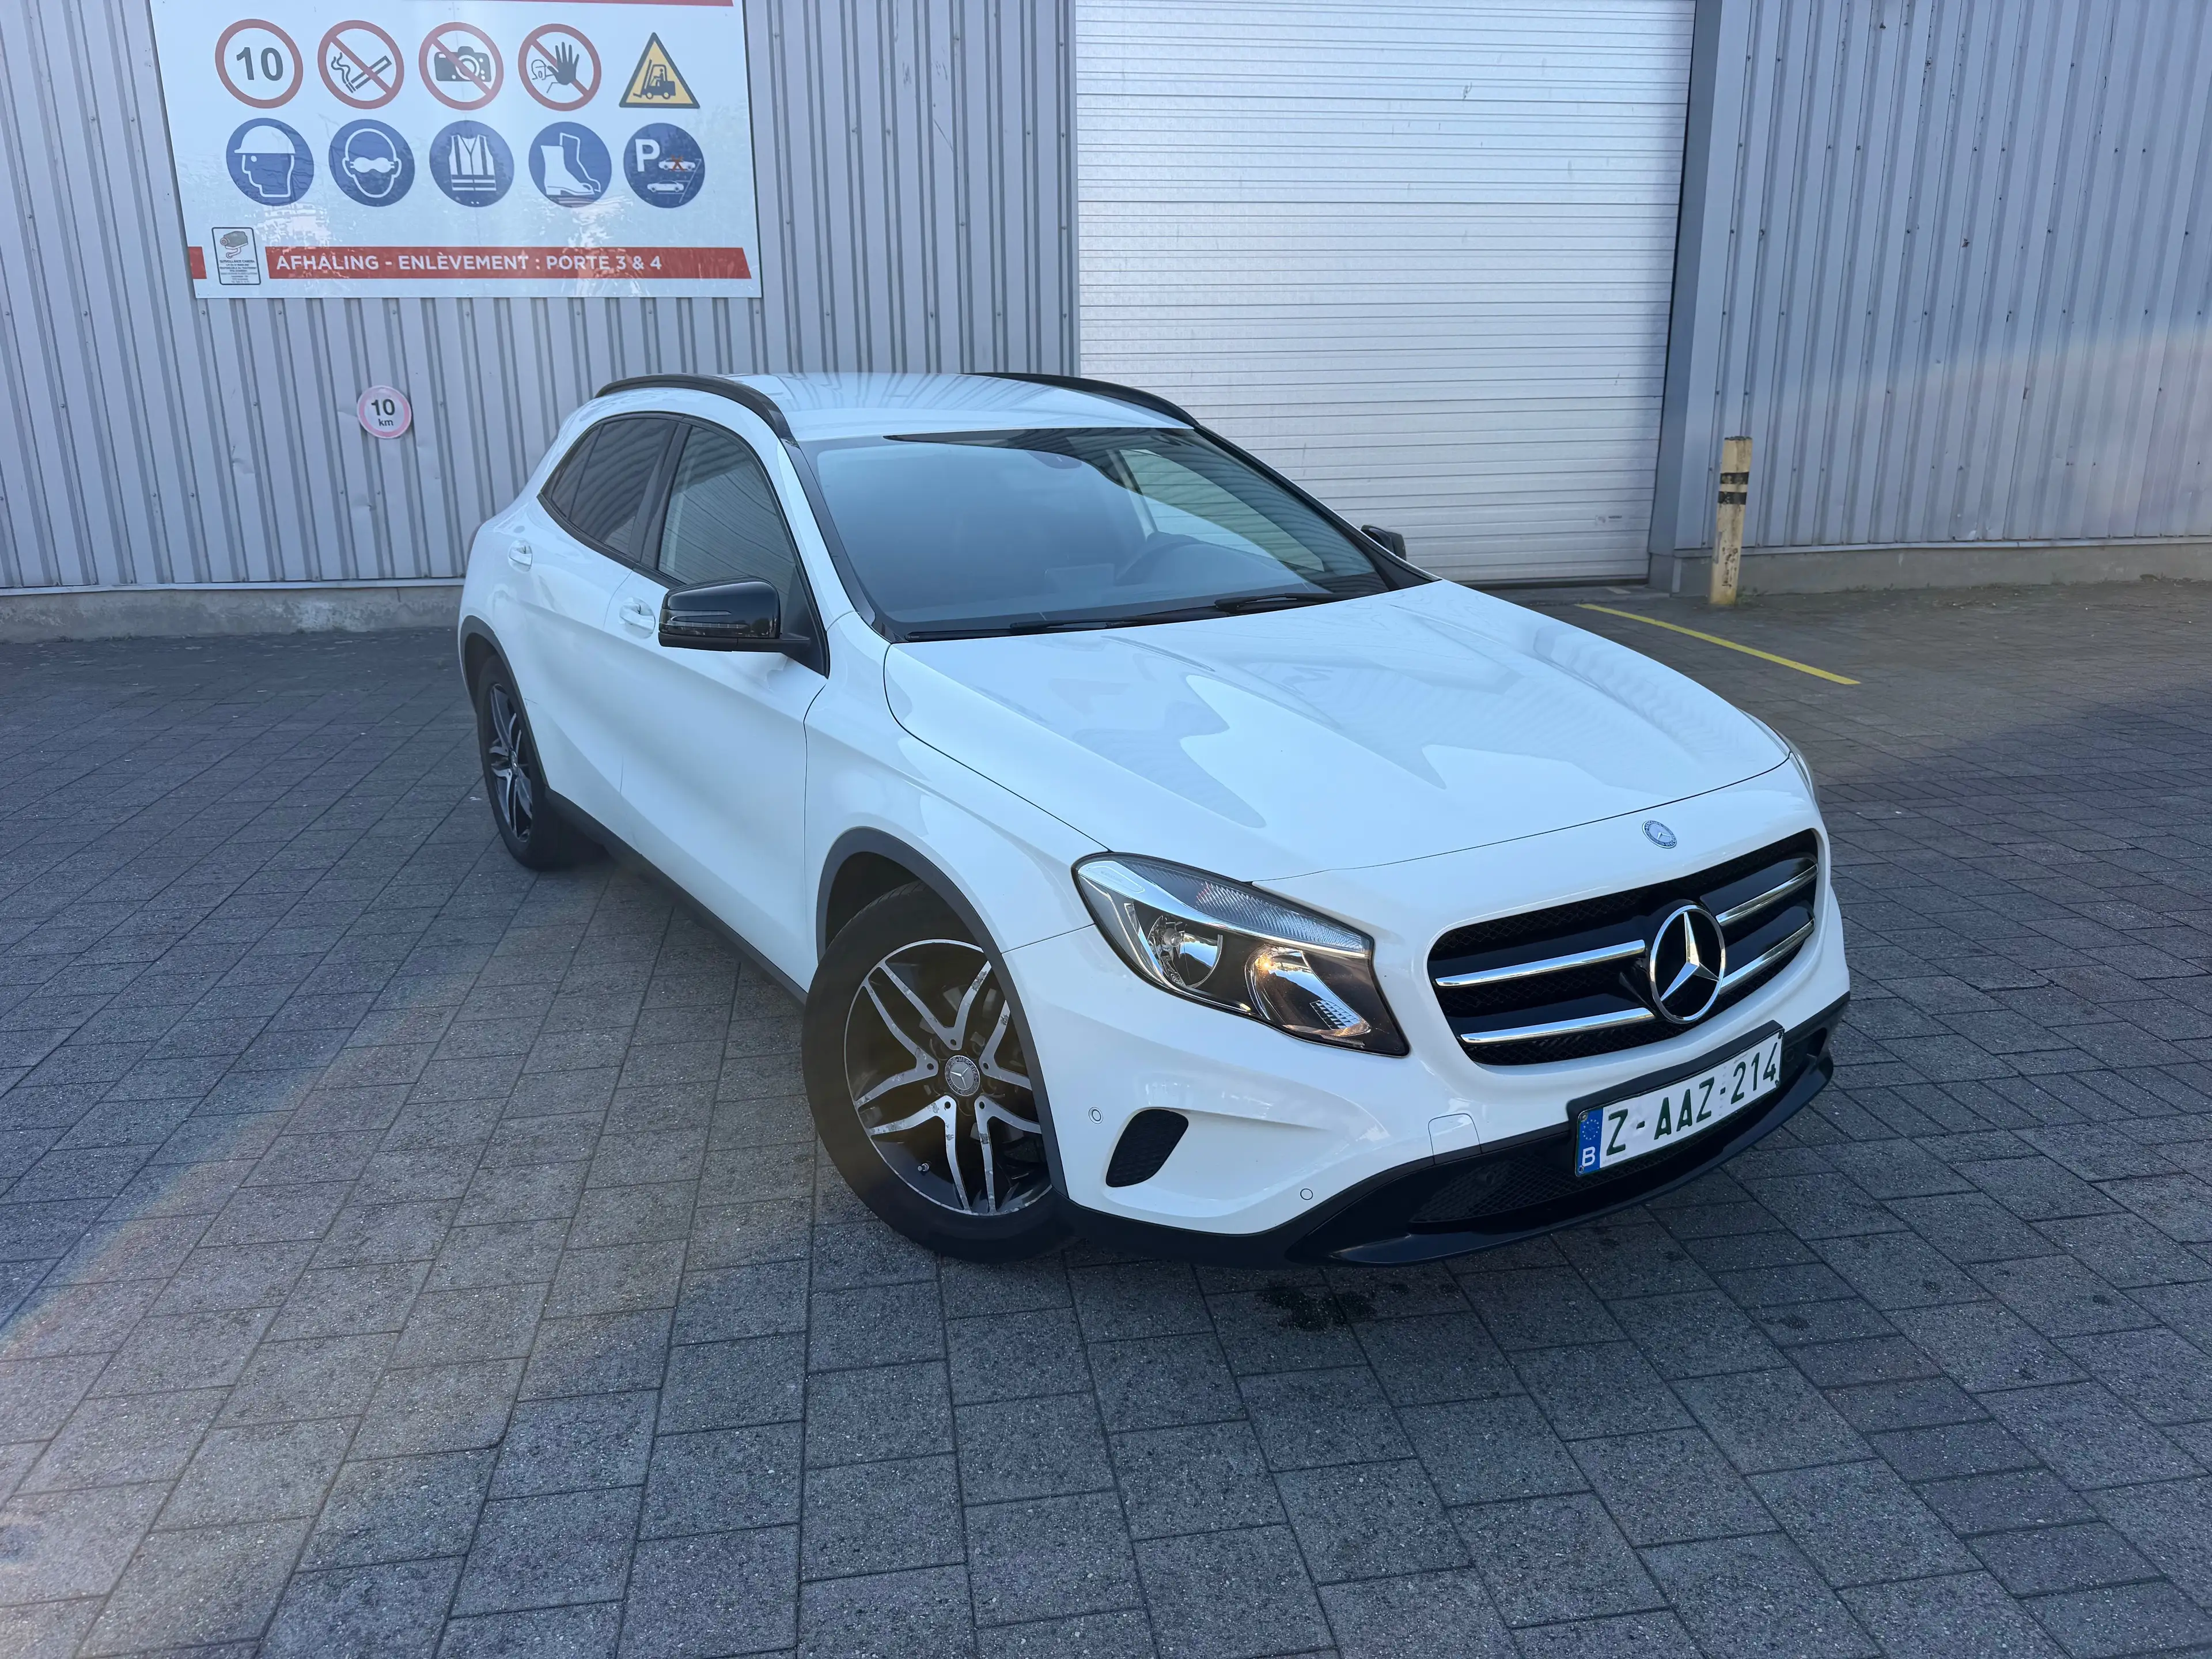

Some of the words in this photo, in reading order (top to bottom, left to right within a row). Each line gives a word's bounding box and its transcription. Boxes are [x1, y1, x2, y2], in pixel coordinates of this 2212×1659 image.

[236, 47, 283, 81] 10
[635, 139, 660, 172] P
[276, 255, 379, 270] AFHALING
[399, 252, 529, 270] ENLÈVEMENT
[547, 255, 610, 270] PORTE
[616, 255, 627, 270] 3
[632, 255, 645, 270] &
[650, 255, 662, 270] 4
[371, 399, 395, 416] 10
[378, 418, 393, 426] km
[957, 1056, 979, 1080] MERCEDES
[1606, 1041, 1778, 1156] Z-AAZ-214
[1582, 1146, 1596, 1167] B
